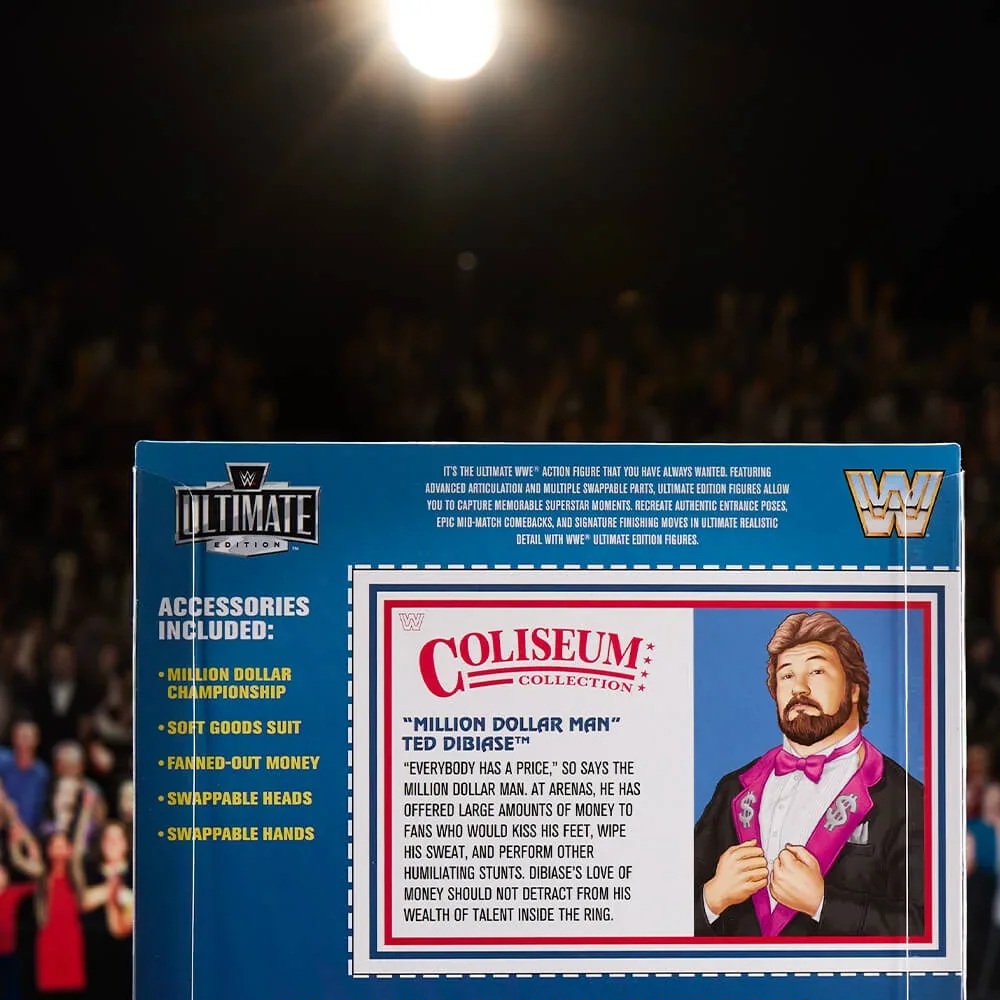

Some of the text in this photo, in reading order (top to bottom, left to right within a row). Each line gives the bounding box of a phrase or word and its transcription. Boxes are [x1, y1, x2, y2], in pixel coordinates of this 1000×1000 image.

[425, 482, 789, 494] ADVANCED ARTICULATION AND MULTIPLE SWAPPABLE PARTS, ULTIMATE EDITION FIGURES ALLOW
[182, 494, 312, 535] ULTIMATE
[158, 596, 309, 617] ACCESSORIES
[158, 620, 273, 640] INCLUDED:
[419, 627, 644, 698] COLISEUM
[167, 667, 291, 681] MILLION DOLLAR
[167, 685, 286, 699] CHAMPIONSHIP
[519, 675, 633, 693] COLLECTION
[167, 719, 301, 735] SOFT GOODS SUIT
[492, 716, 563, 733] DOLLAR
[401, 736, 436, 751] TED
[167, 755, 320, 770] FANNED-OUT MONEY
[404, 781, 640, 797] MILLION DOLLAR MAN. AT ARENAS, HE HAS
[167, 790, 312, 805] SWAPPABLE HEADS
[404, 802, 632, 817] OFFERED LARGE AMOUNTS OF MONEY TO
[167, 826, 314, 841] SWAPPABLE HANDS
[404, 823, 626, 839] FANS WHO WOULD KISS HIS FEET, WIPE
[404, 844, 594, 860] HIS SWEAT, AND PERFORM OTHER
